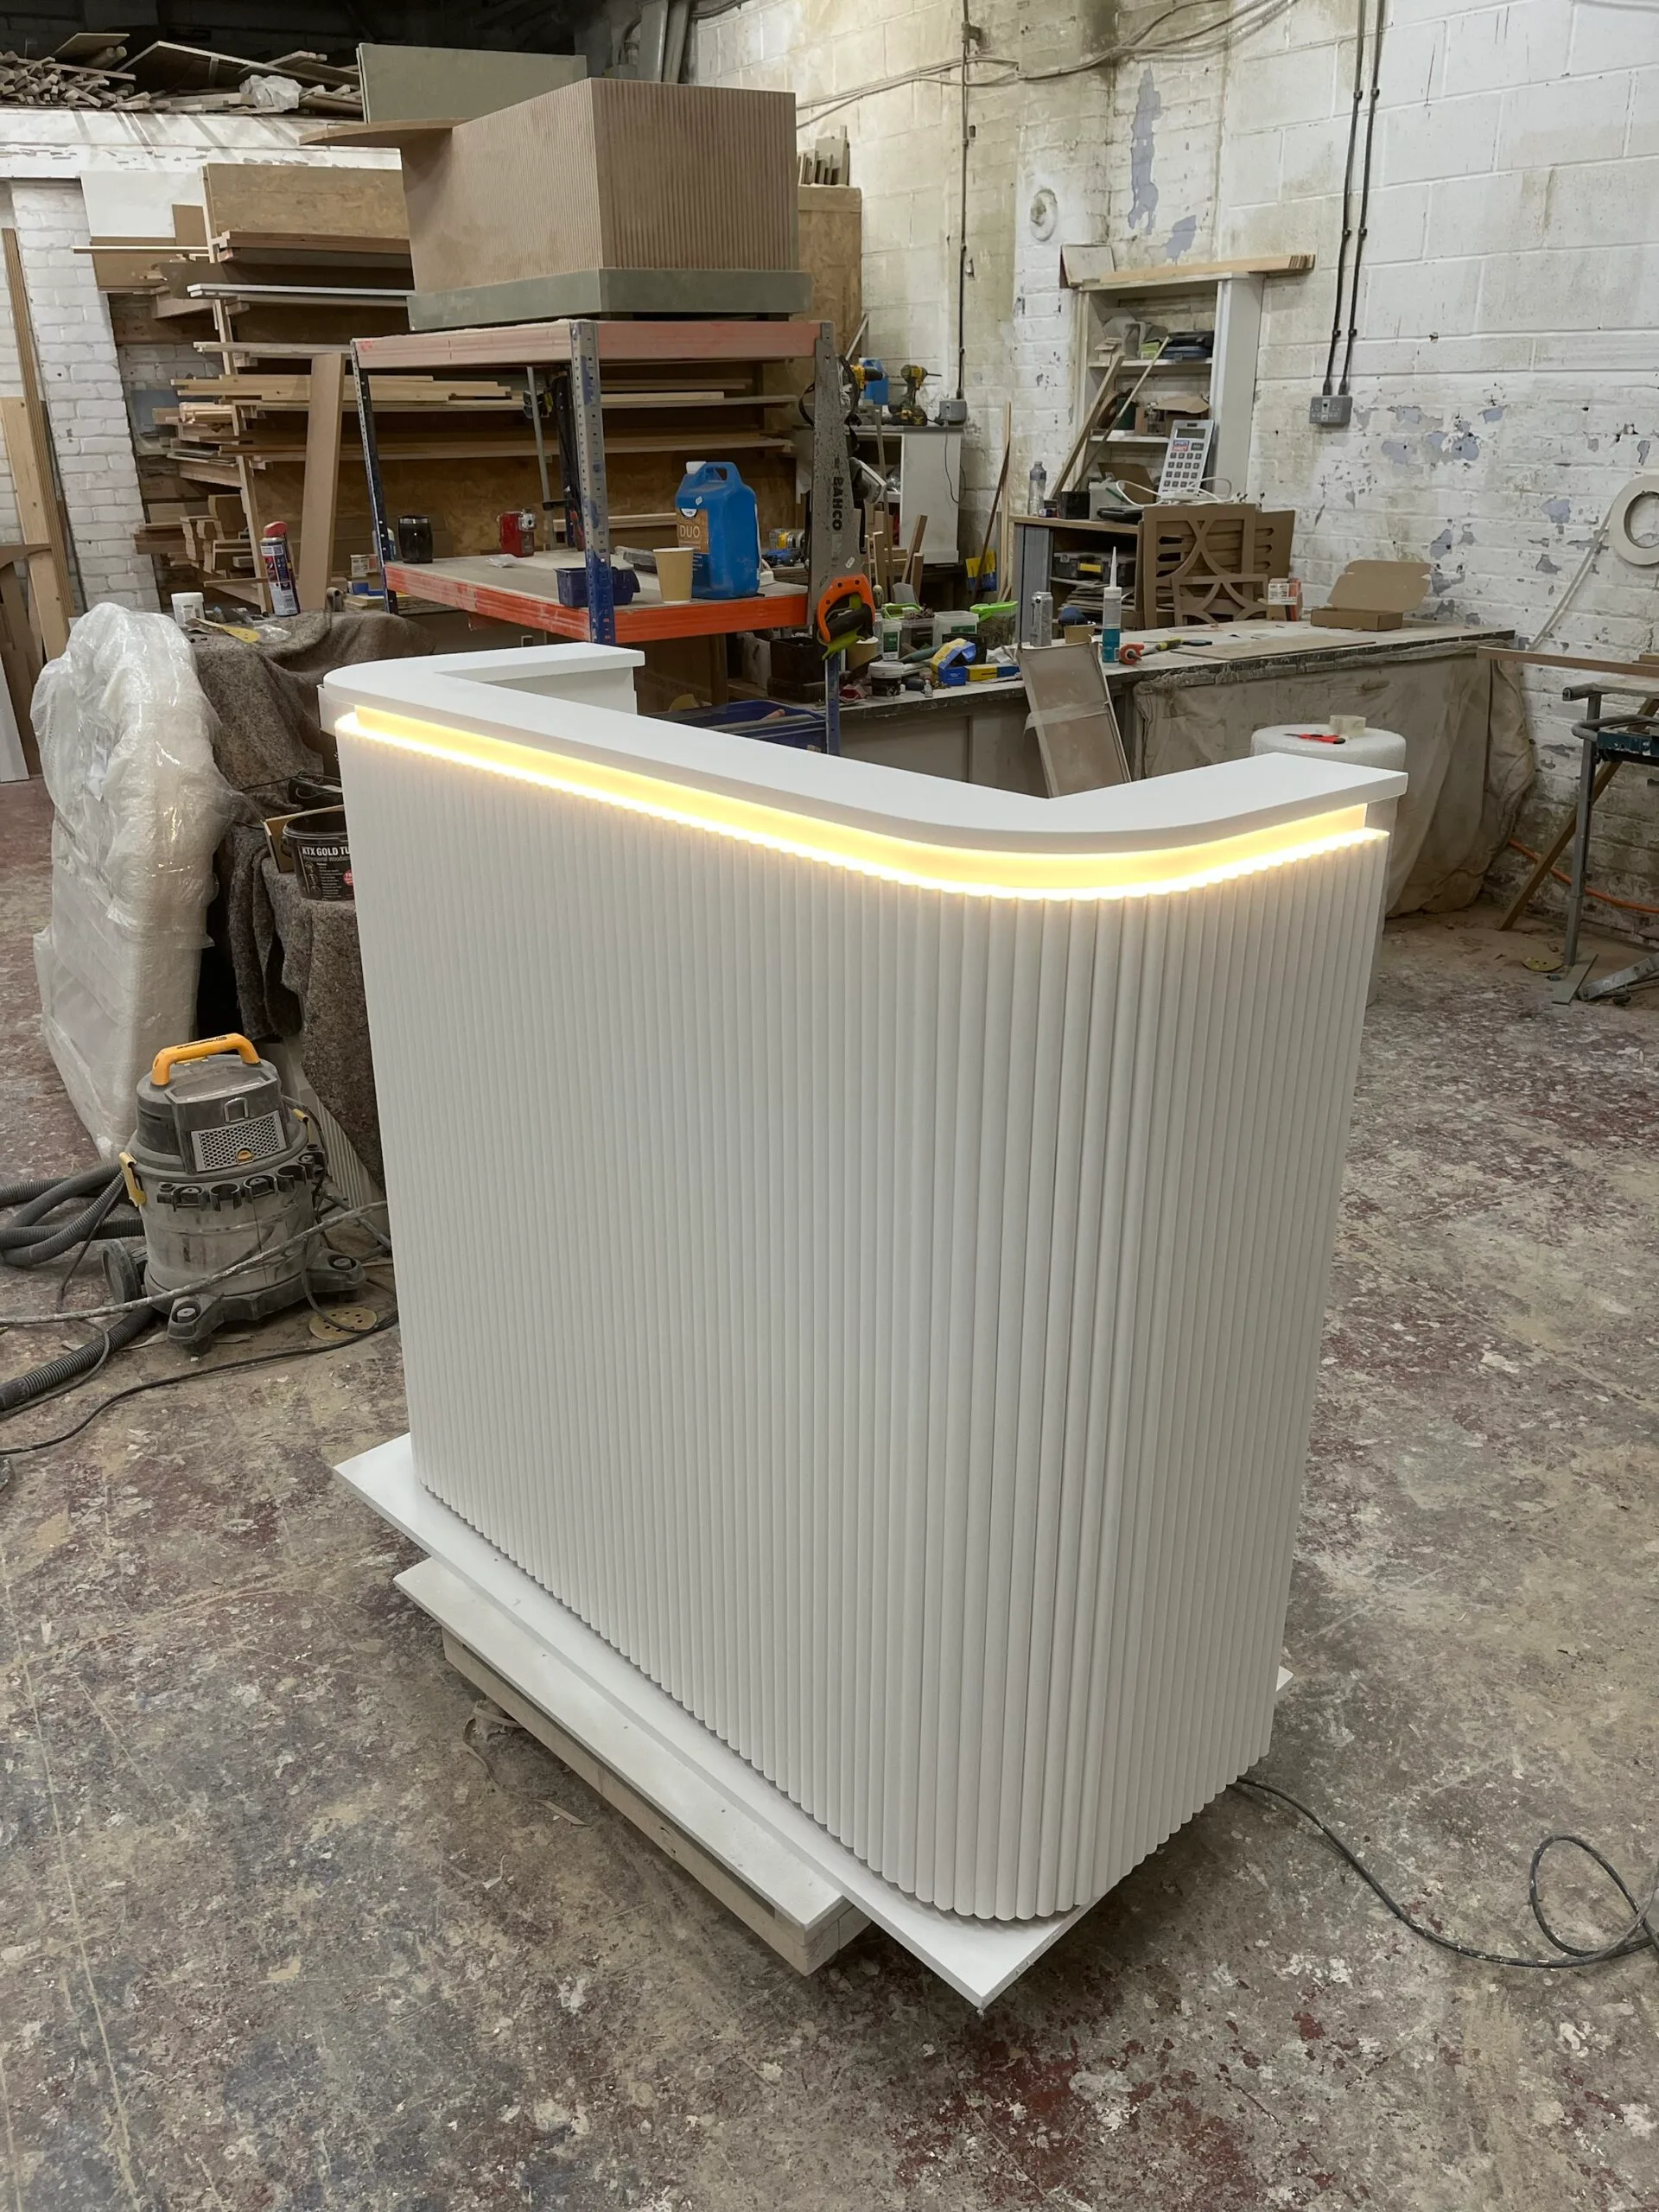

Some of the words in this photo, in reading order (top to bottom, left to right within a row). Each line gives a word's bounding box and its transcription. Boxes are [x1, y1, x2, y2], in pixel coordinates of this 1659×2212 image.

[832, 476, 844, 531] BAHCO
[679, 524, 701, 538] DUO
[316, 848, 338, 856] GOLD
